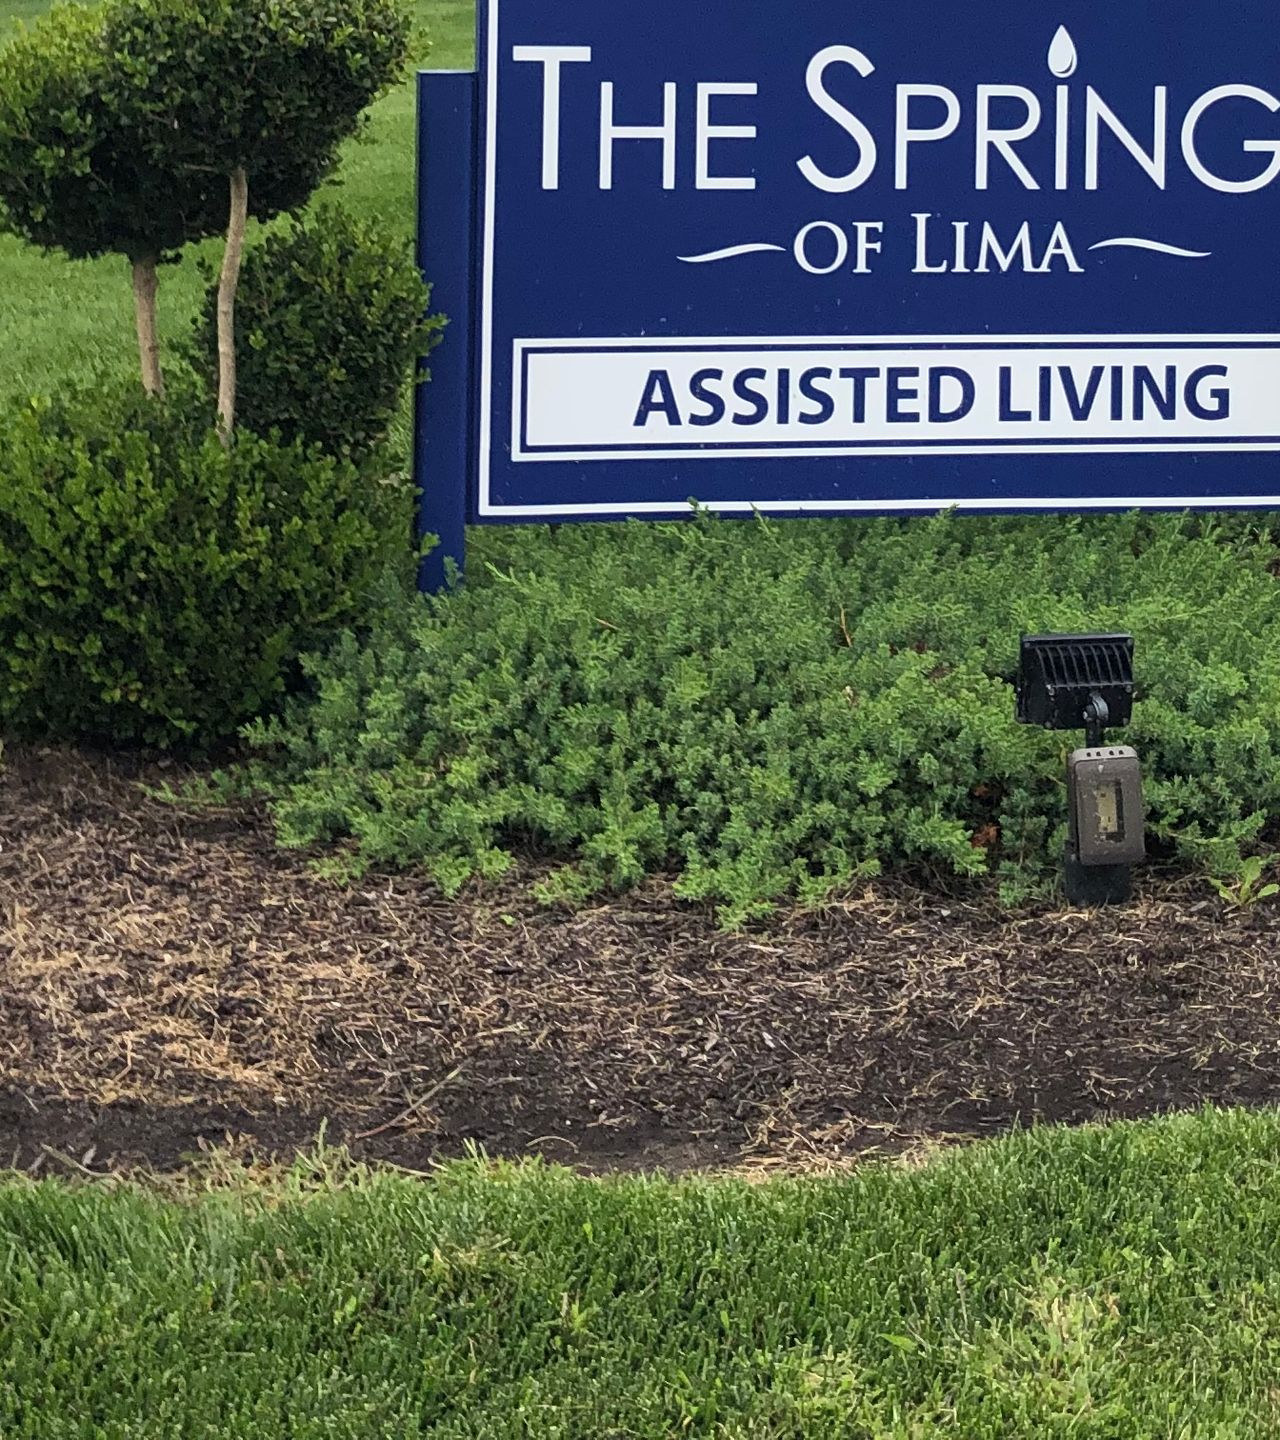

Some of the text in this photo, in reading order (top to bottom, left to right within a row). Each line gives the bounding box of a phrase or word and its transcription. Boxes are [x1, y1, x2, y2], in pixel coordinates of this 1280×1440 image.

[512, 45, 758, 190] THE
[793, 213, 1085, 275] OF LIMA
[632, 364, 1230, 427] ASSISTED LIVING
